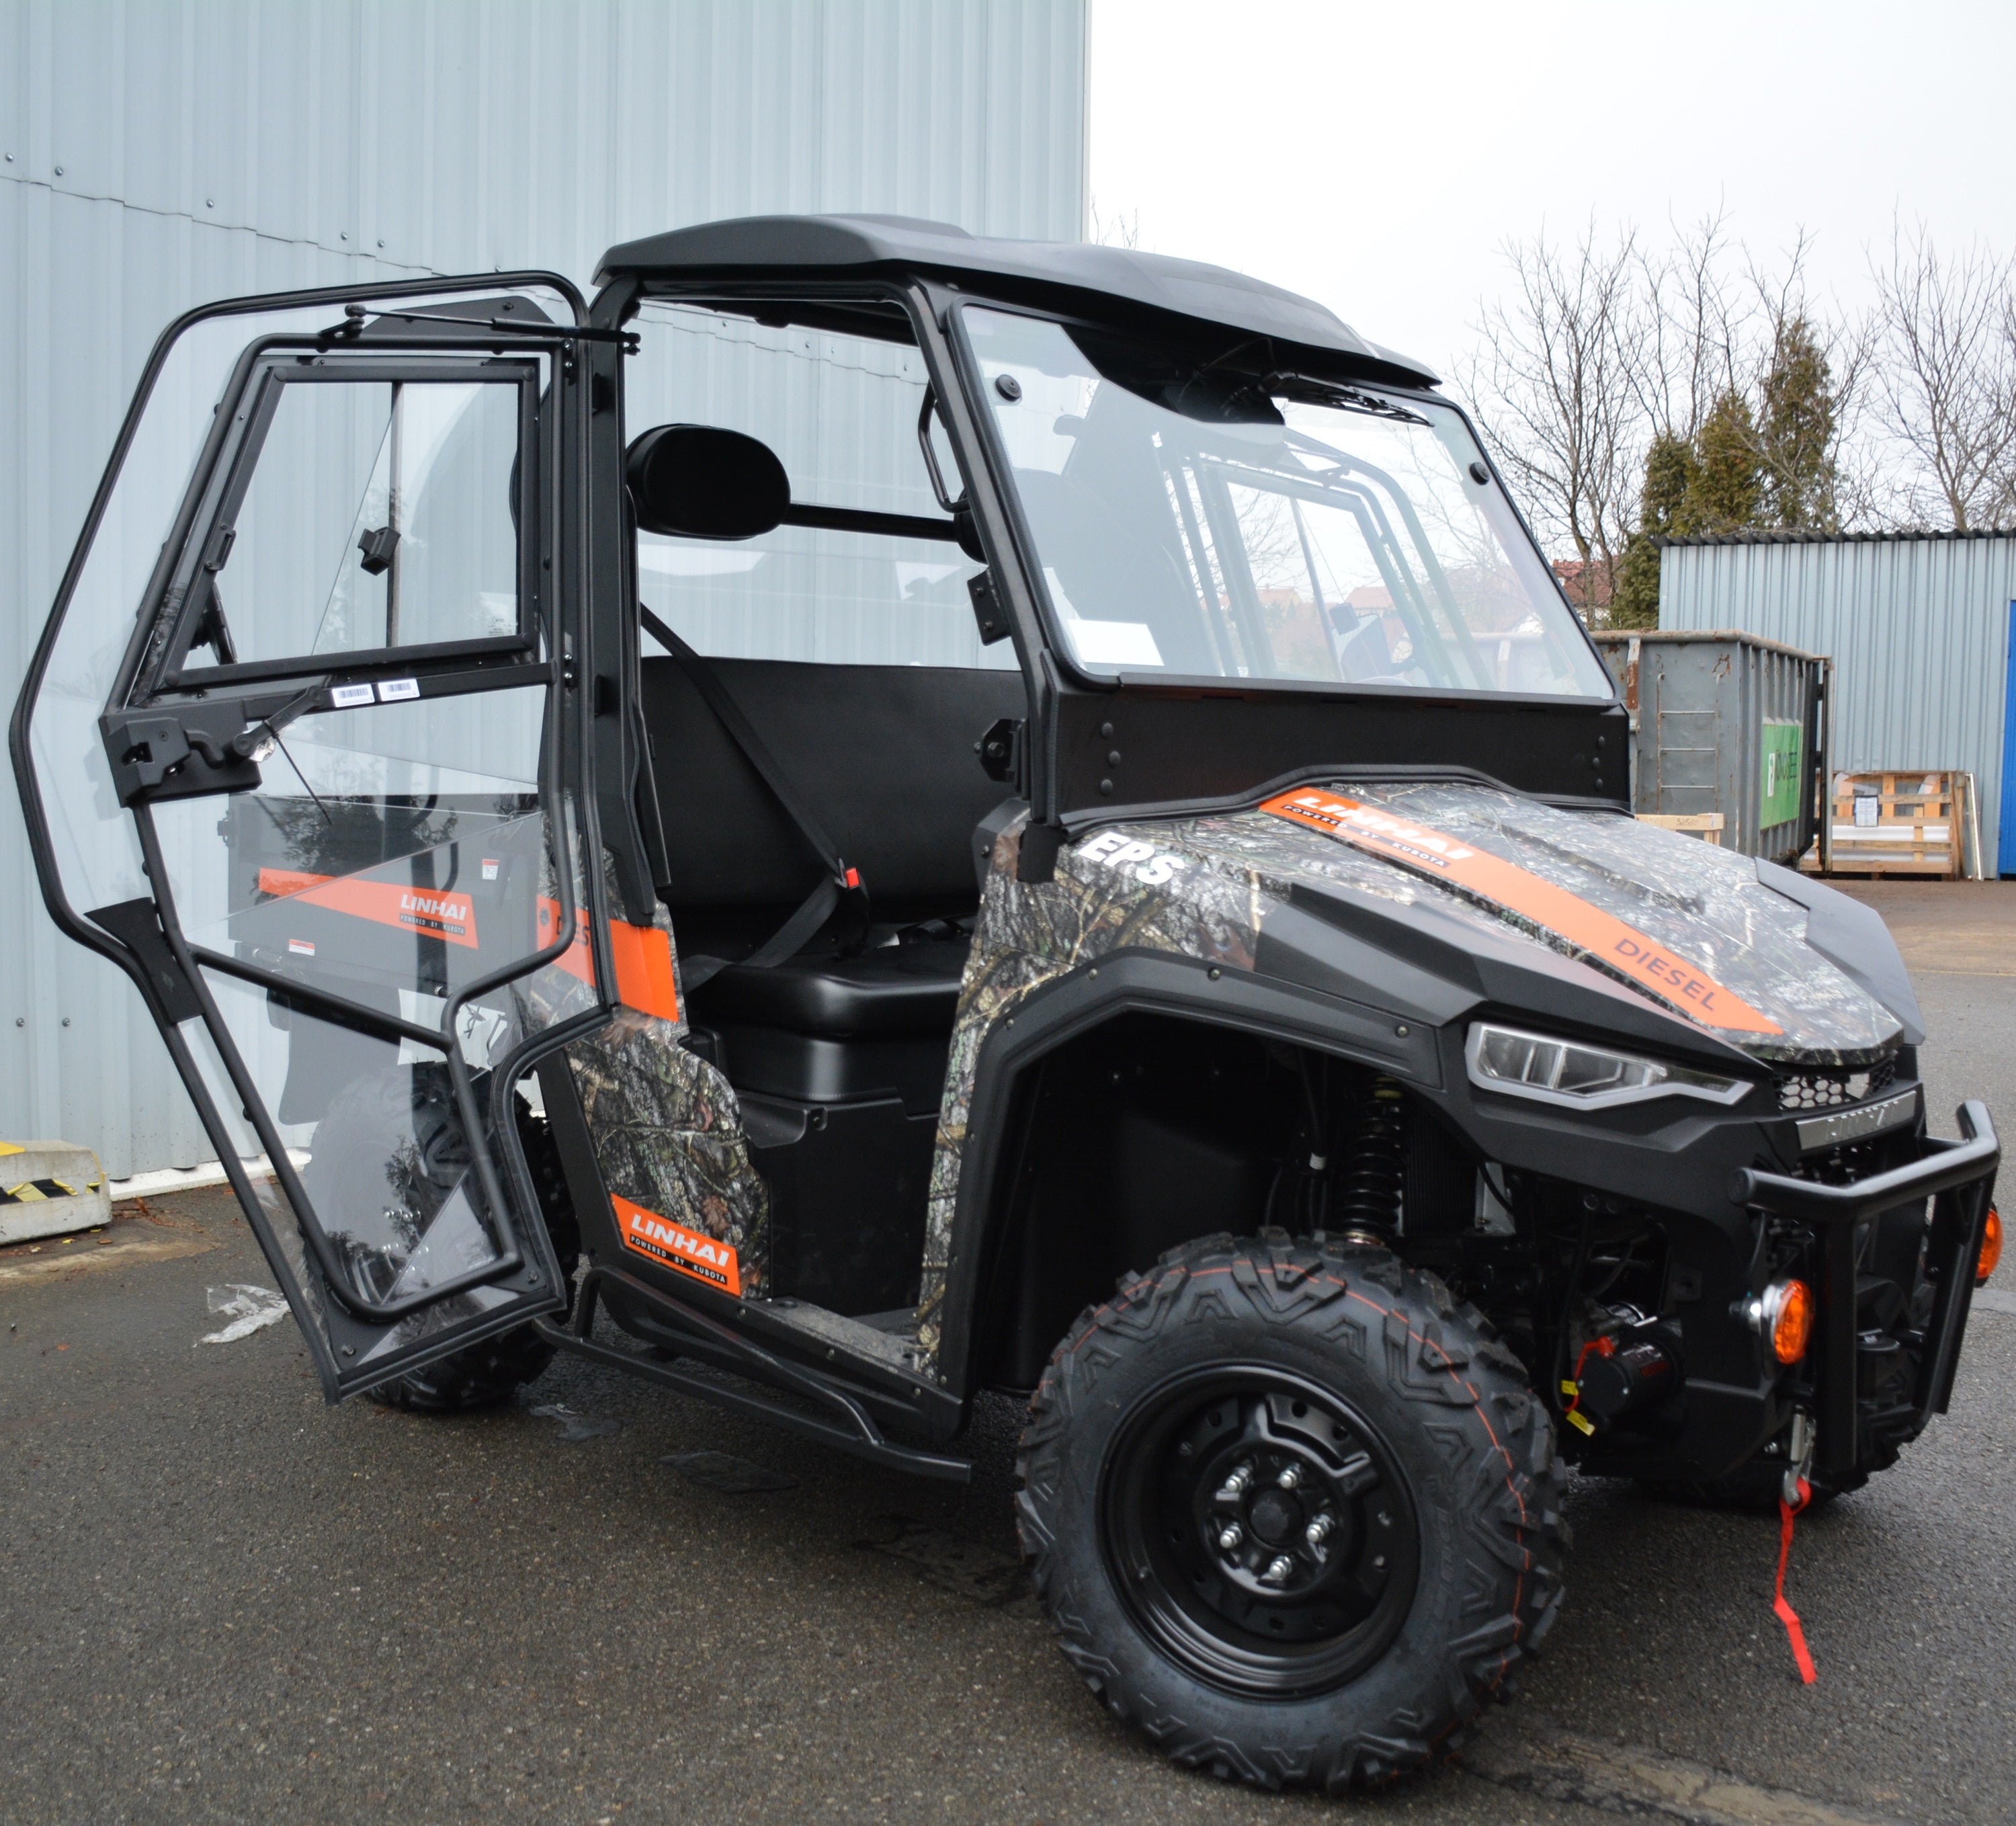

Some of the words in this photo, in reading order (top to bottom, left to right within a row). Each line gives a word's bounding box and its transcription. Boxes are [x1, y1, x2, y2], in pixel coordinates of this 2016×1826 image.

[1284, 805, 1347, 828] POWERED
[1360, 831, 1379, 839] BY
[1392, 842, 1445, 867] KUBOTA
[1293, 797, 1474, 860] LINHAI
[1078, 831, 1185, 884] EPS
[401, 895, 466, 921] LINHAI
[401, 915, 426, 925] POWERED
[444, 925, 464, 933] KUBOTA
[1614, 938, 1715, 1011] DIESEL
[630, 1236, 667, 1257] POWERED
[675, 1257, 685, 1265] BY
[694, 1264, 726, 1283] KUBOTA
[631, 1214, 730, 1268] LINHAI
